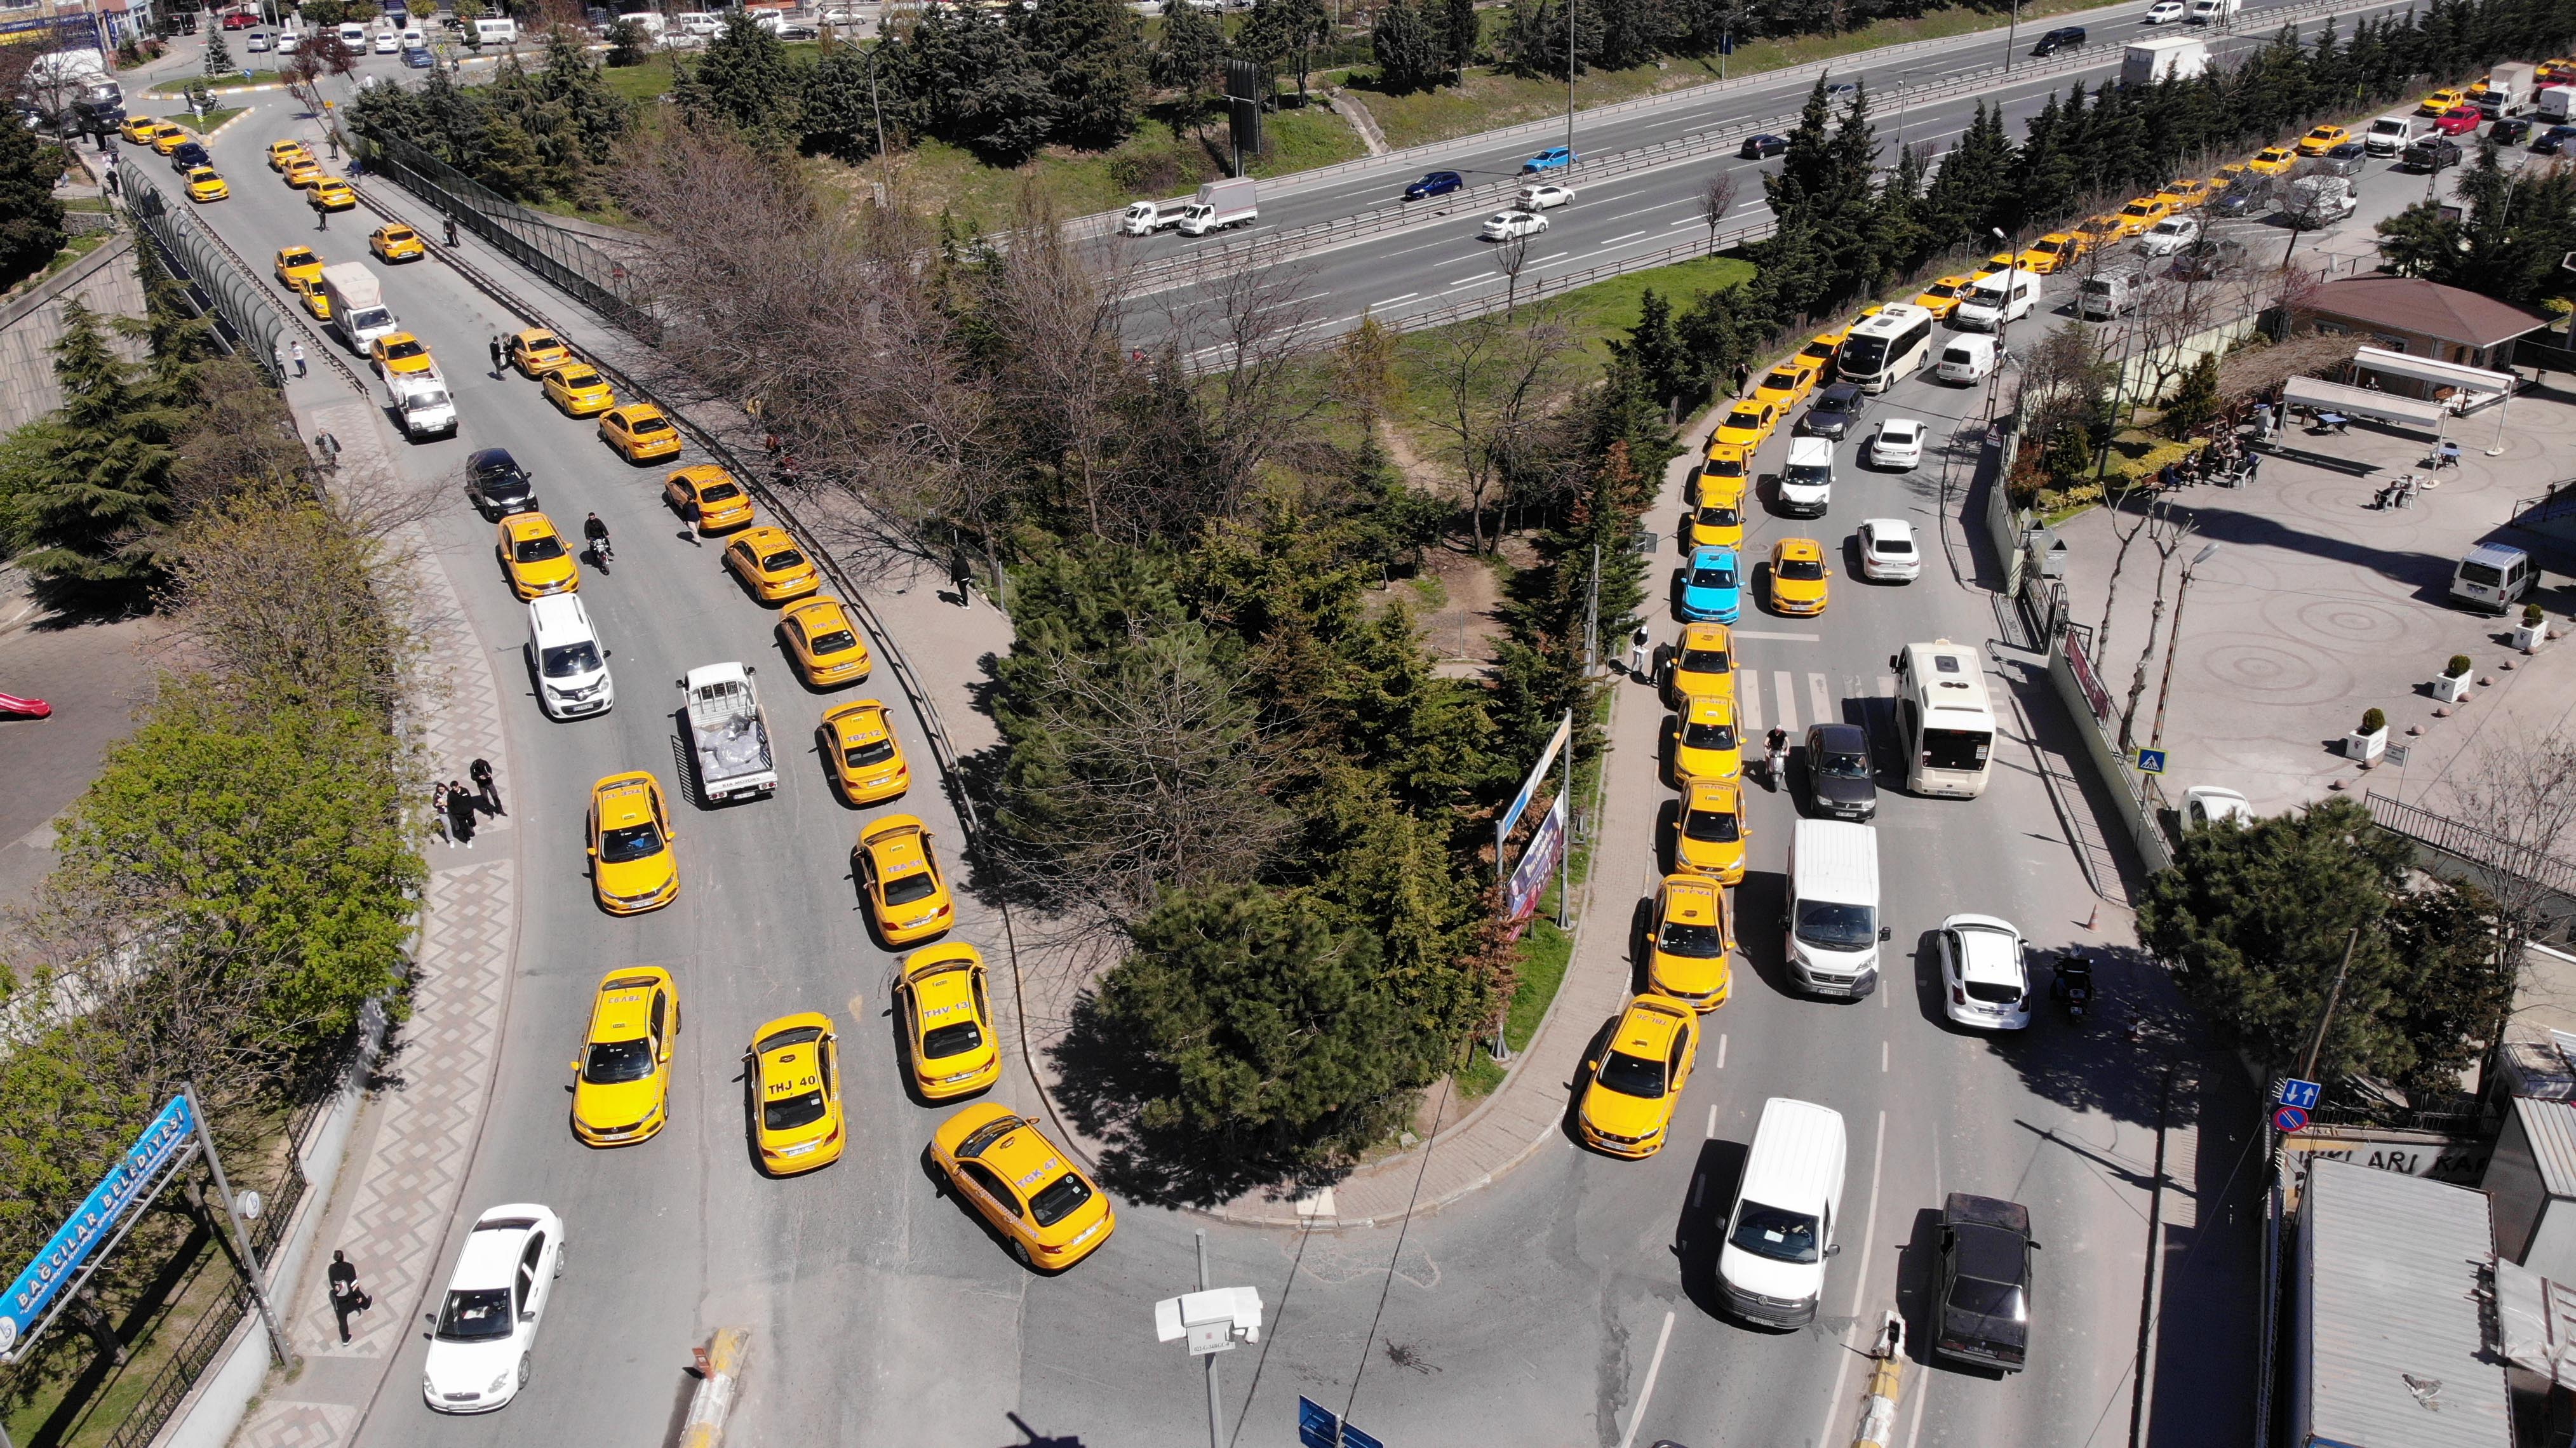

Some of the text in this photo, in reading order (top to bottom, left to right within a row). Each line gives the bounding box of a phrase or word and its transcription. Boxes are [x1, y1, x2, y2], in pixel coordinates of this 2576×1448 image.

[847, 732, 868, 742] TBZ
[735, 777, 761, 786] MOTORS
[887, 862, 908, 874] TEA
[924, 1001, 969, 1018] THV 13
[768, 1075, 815, 1095] THJ 40
[1016, 1158, 1059, 1188] TGK 47
[17, 1108, 183, 1307] BAĞCILAR BELEDİYESİ
